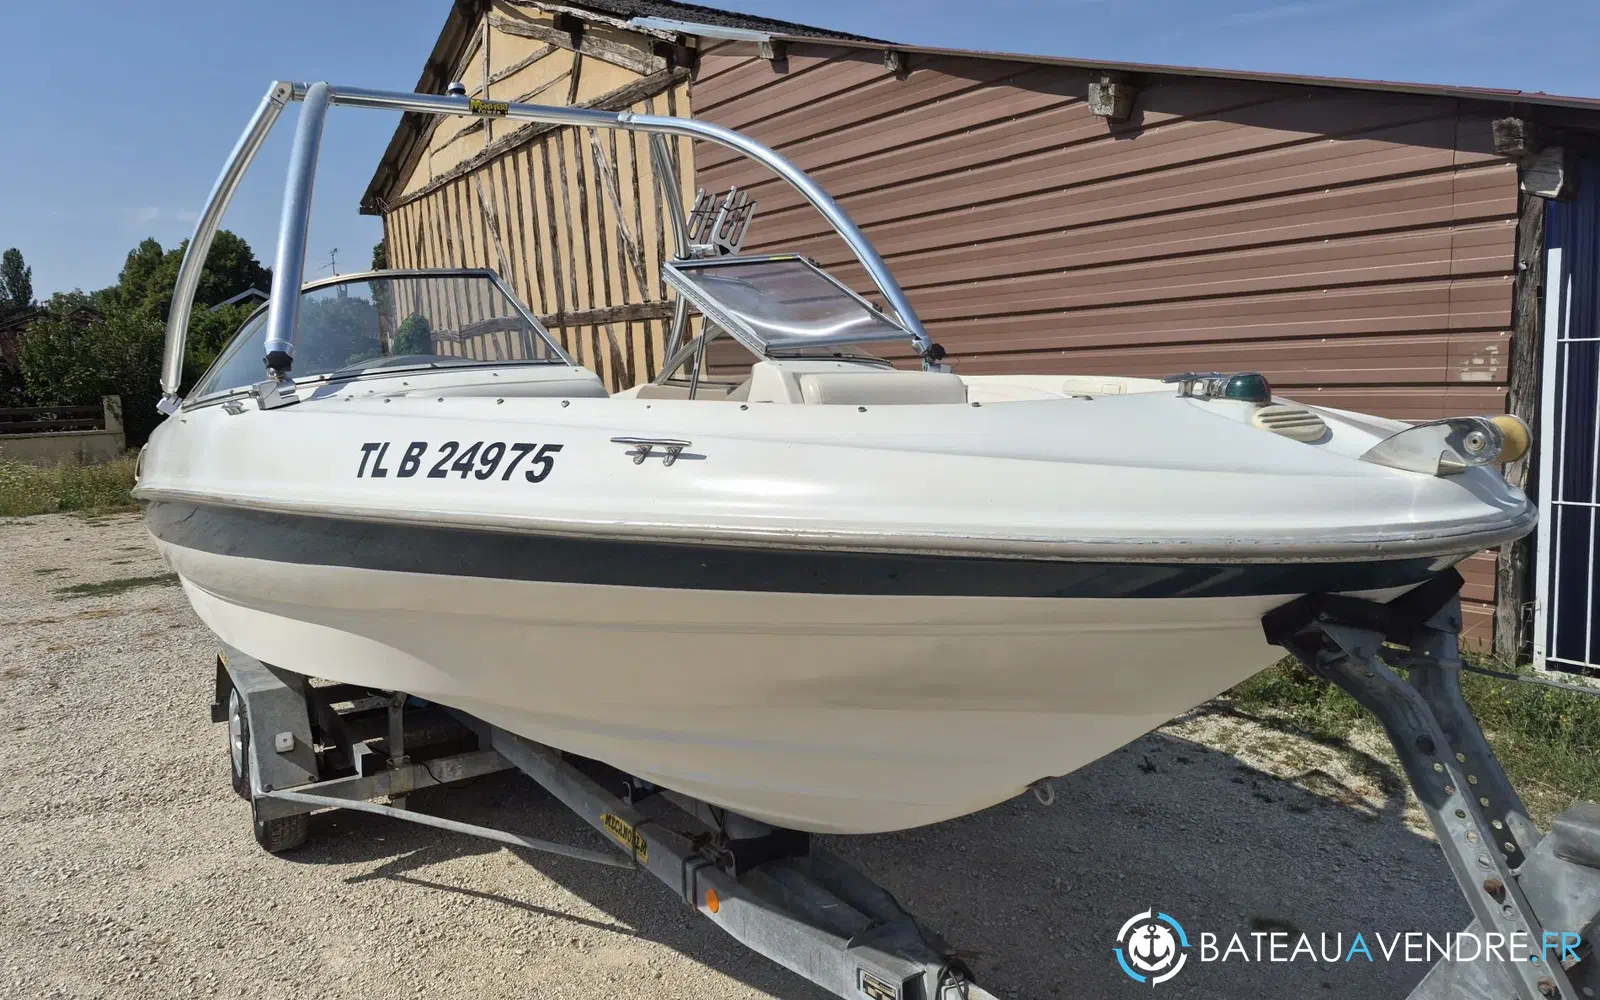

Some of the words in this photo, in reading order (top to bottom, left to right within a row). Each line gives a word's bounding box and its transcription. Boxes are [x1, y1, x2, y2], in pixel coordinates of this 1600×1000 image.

[357, 441, 391, 478] TL
[396, 441, 428, 478] B
[426, 441, 564, 484] 24975
